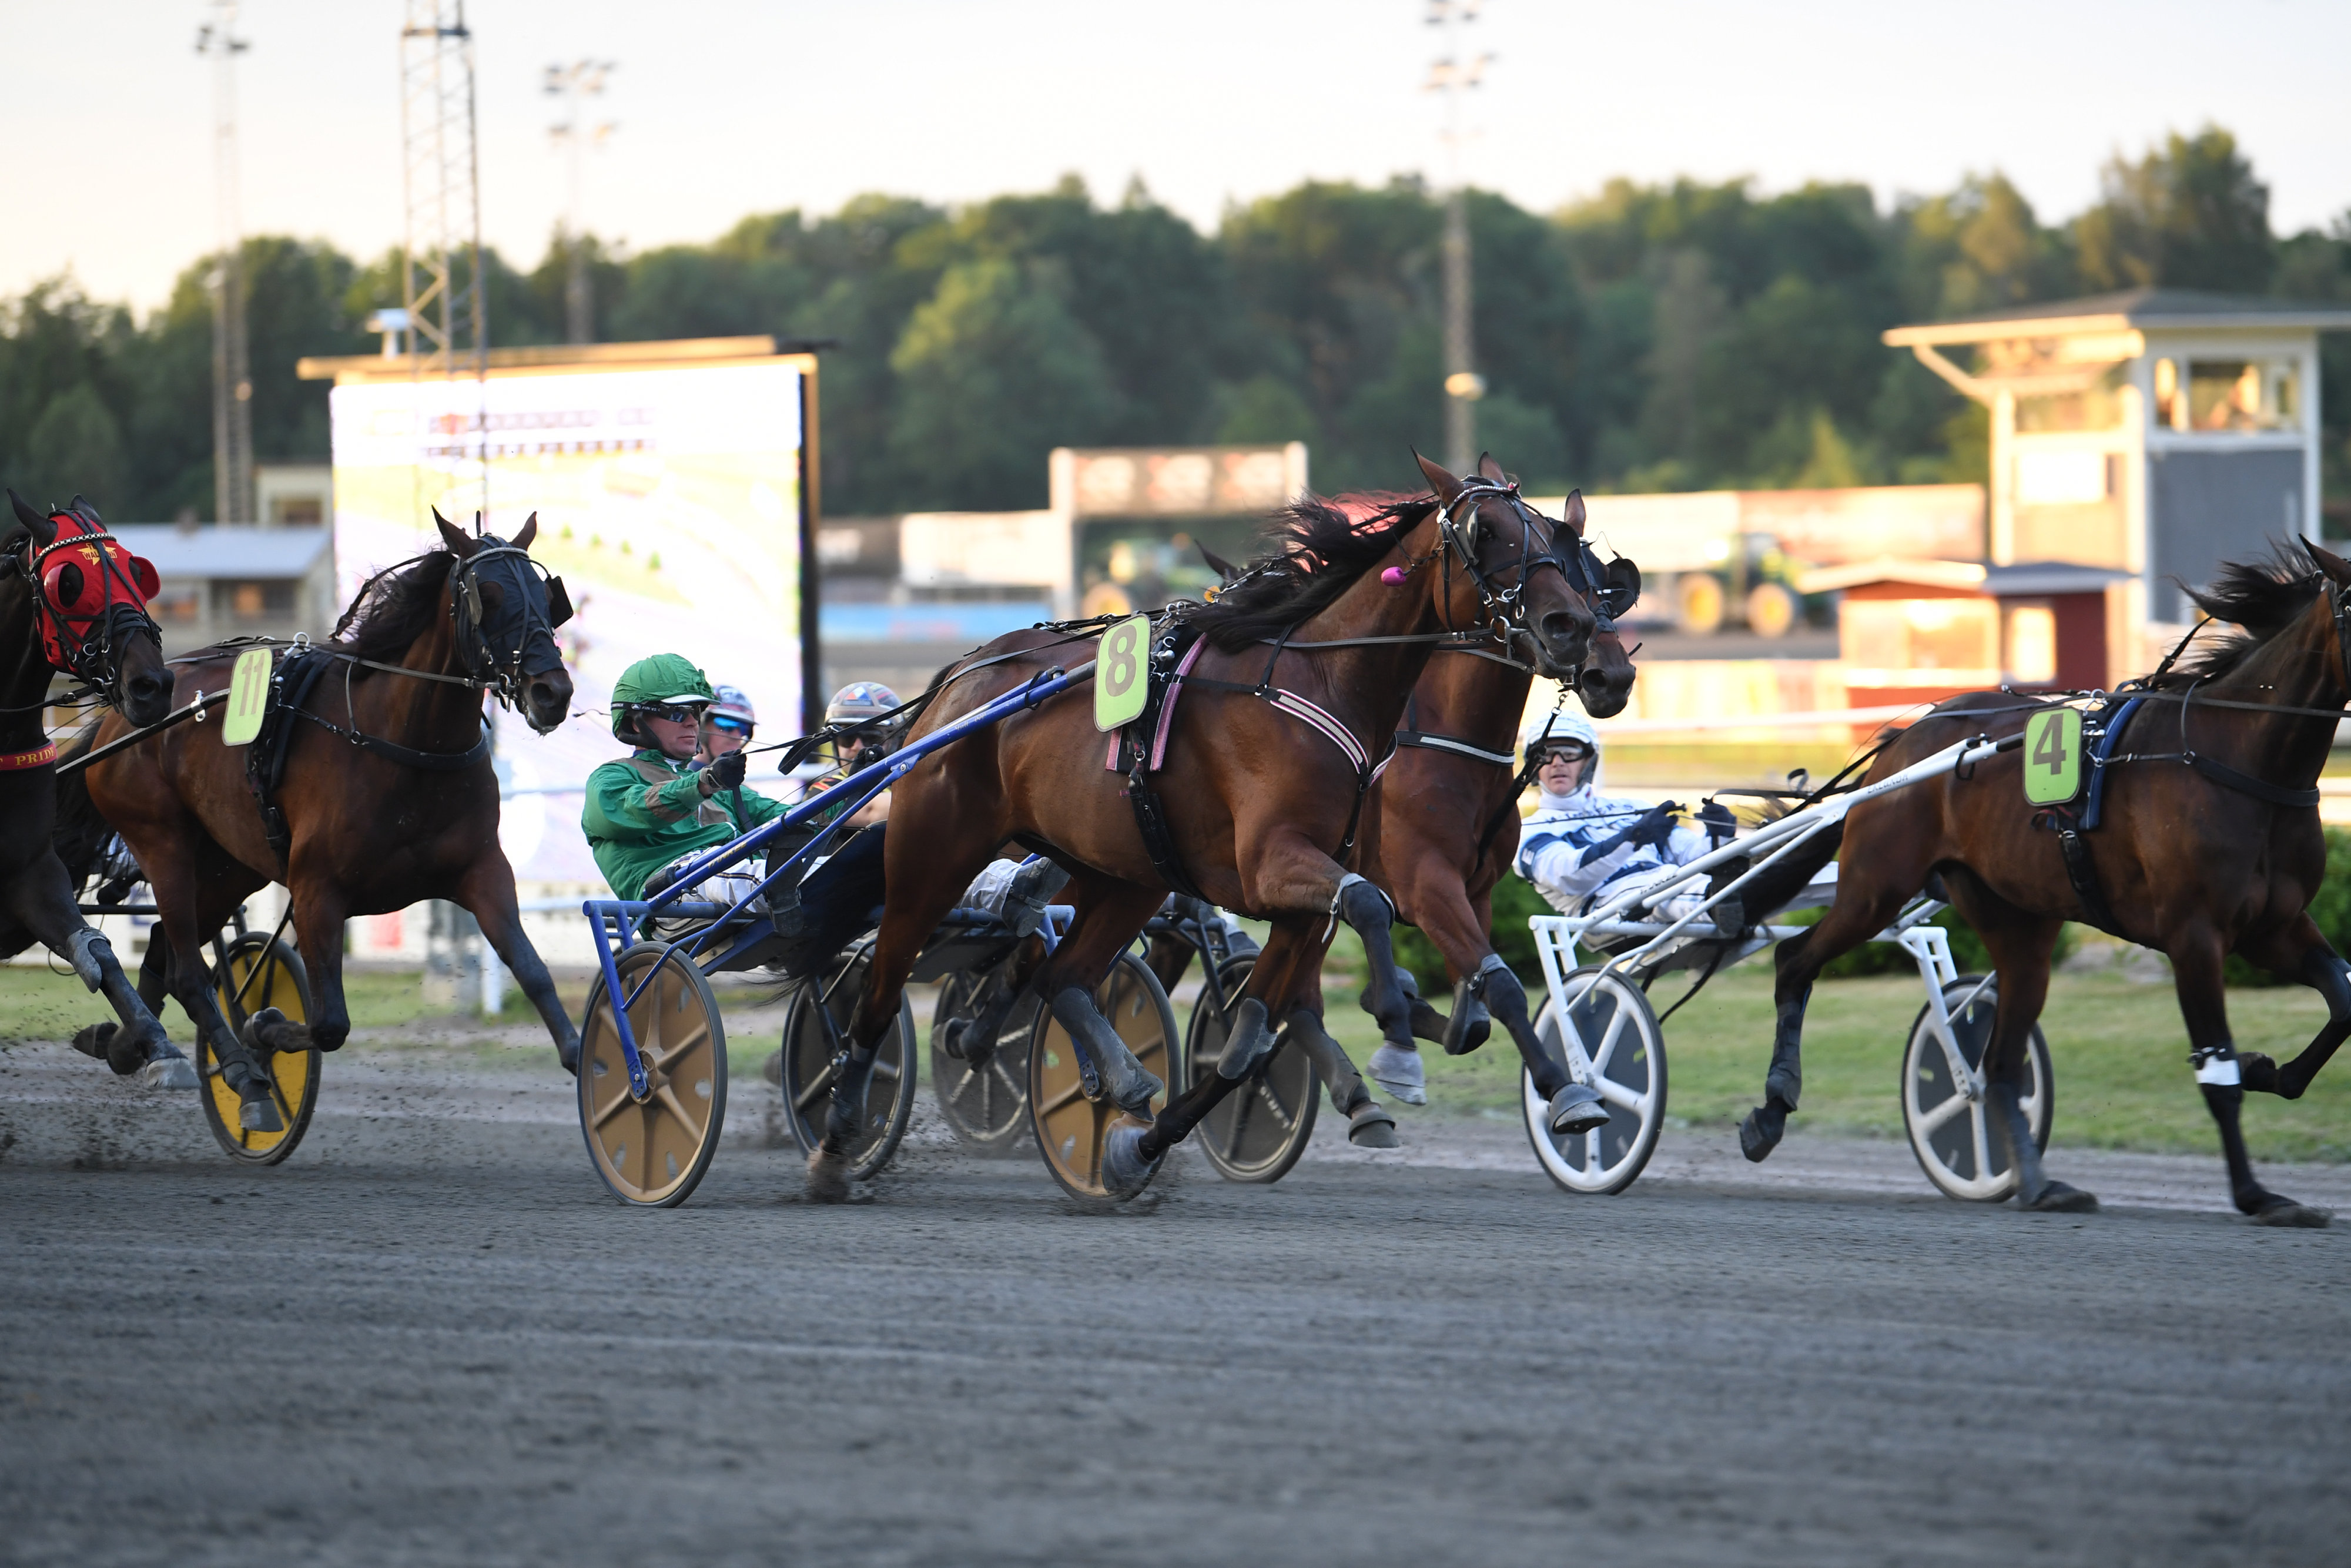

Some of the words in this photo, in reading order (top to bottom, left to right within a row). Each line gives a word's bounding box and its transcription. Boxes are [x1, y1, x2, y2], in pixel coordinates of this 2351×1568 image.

[239, 652, 264, 716] 11
[1105, 624, 1137, 697] 8
[2033, 713, 2067, 775] 4
